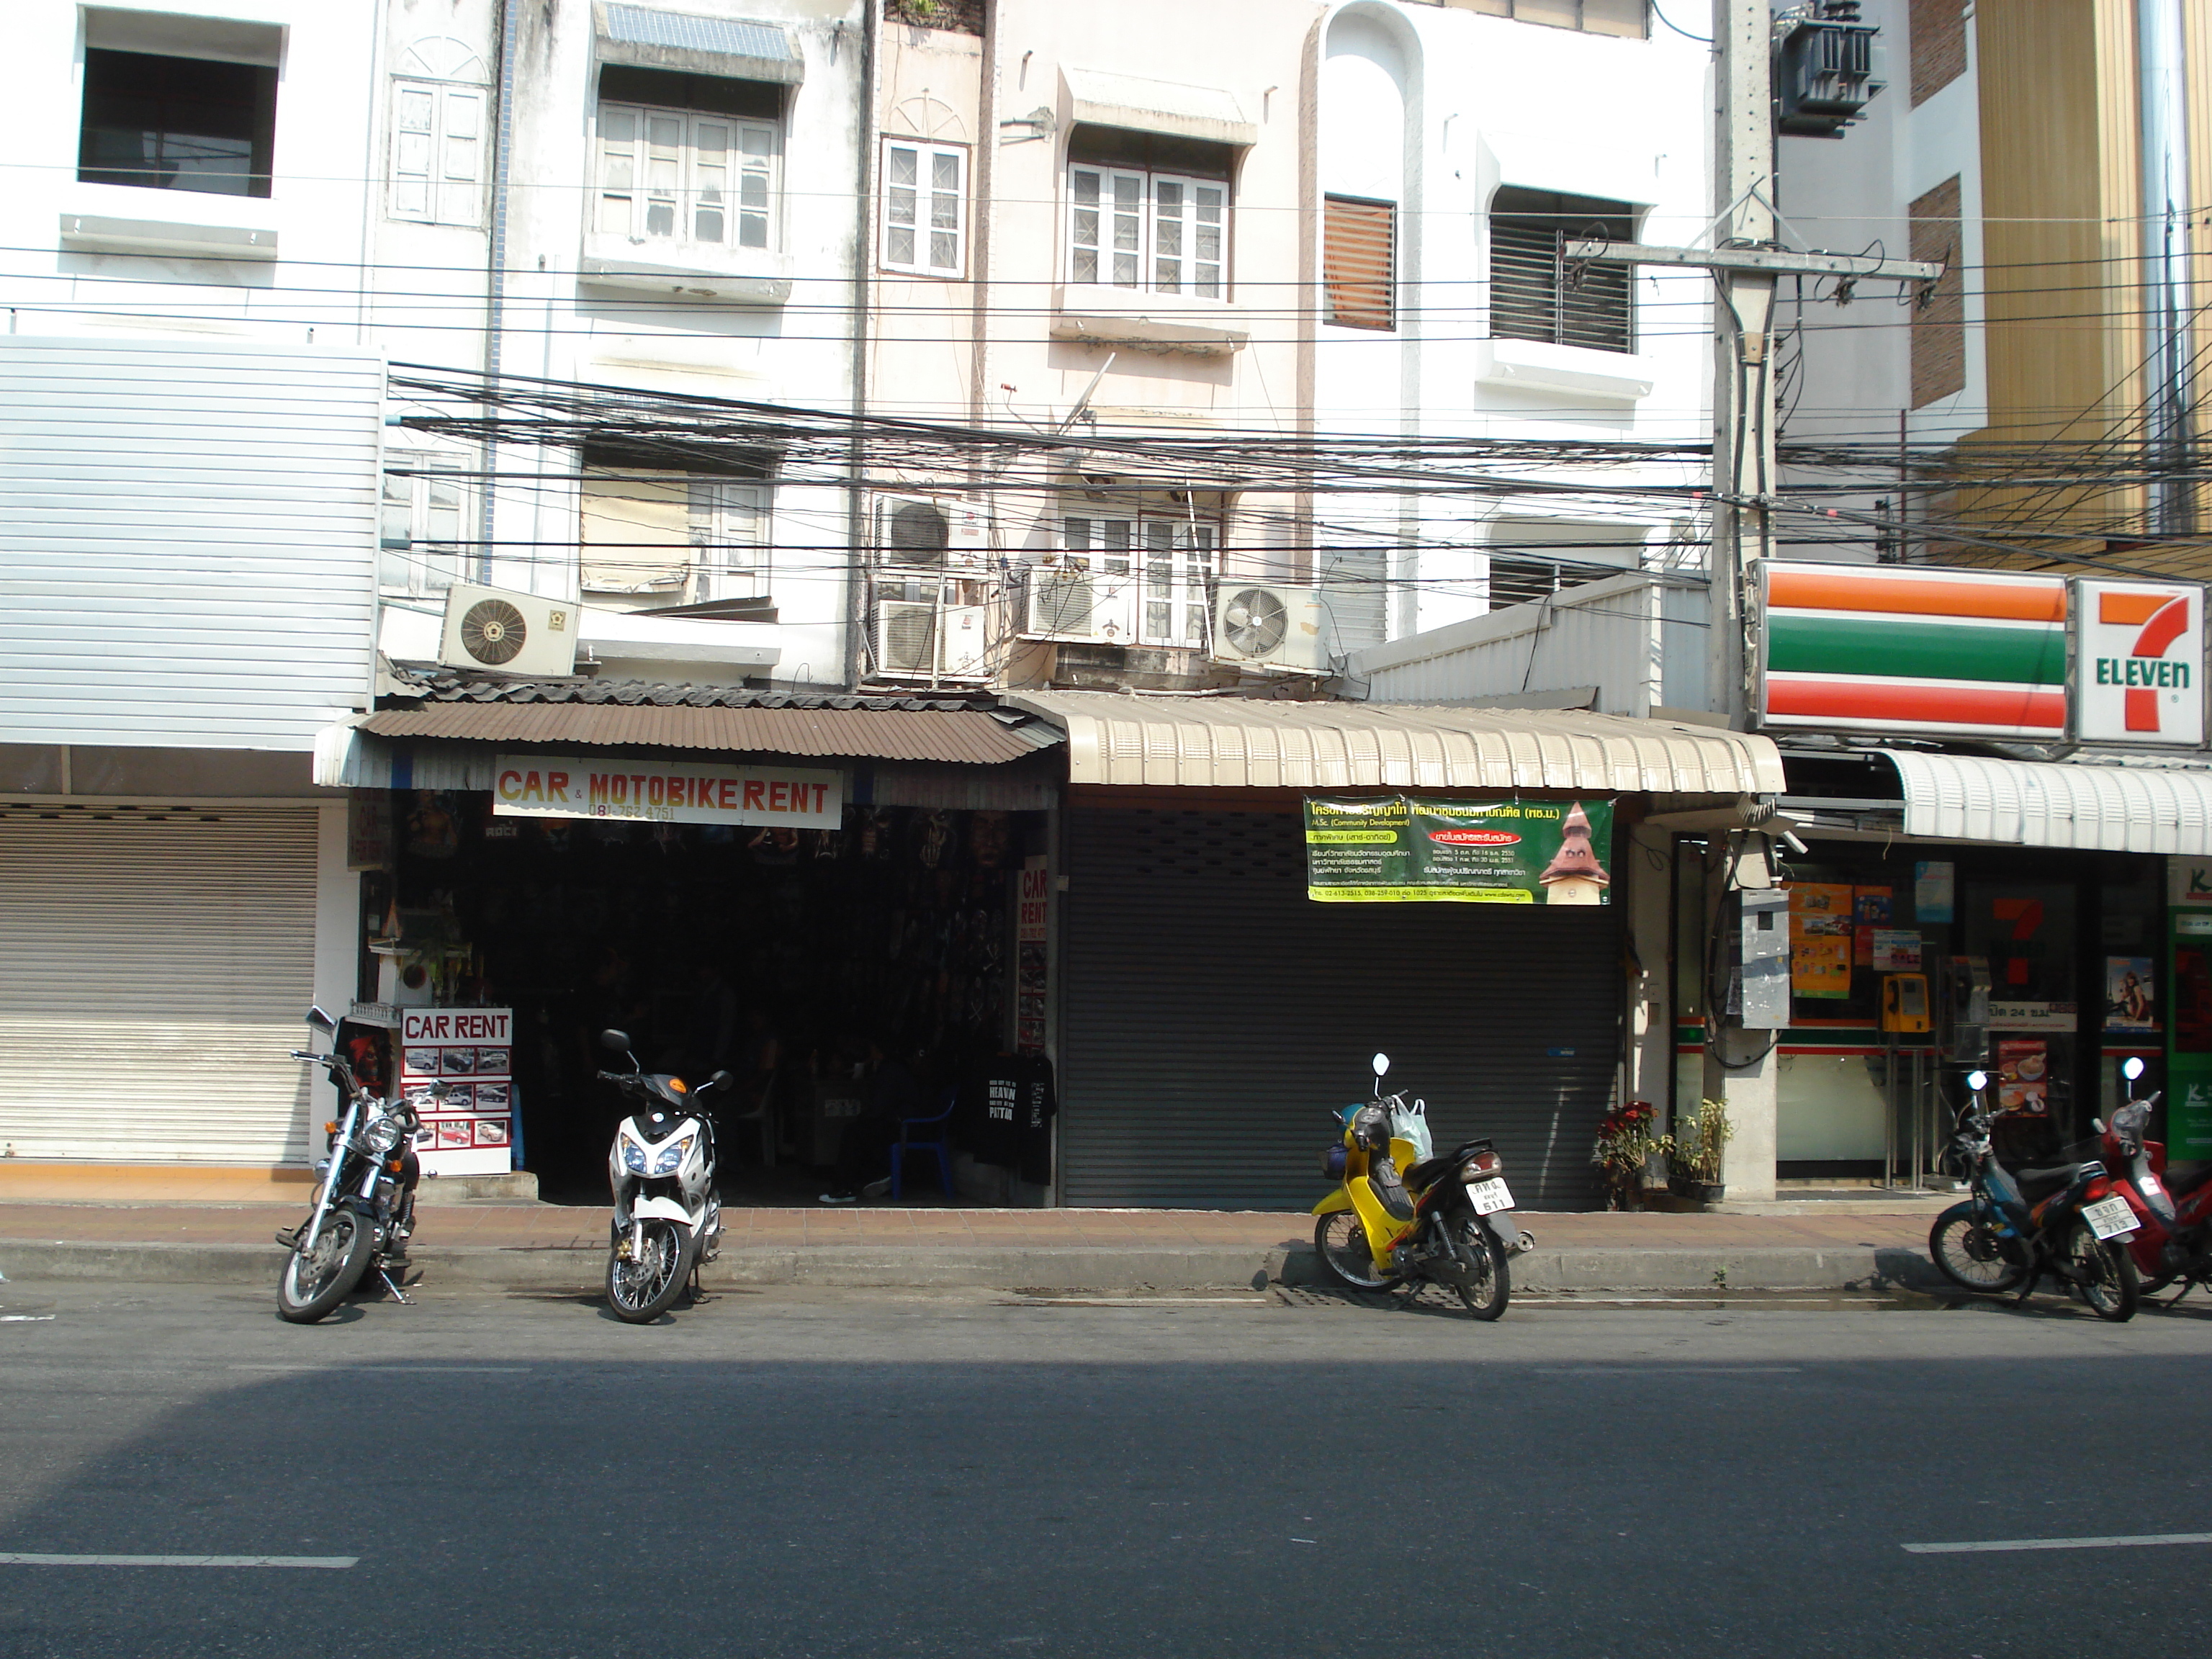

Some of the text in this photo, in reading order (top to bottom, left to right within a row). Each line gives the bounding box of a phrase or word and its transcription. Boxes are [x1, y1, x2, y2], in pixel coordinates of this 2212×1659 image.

[2098, 591, 2189, 732] 7
[498, 770, 569, 803] CAR
[575, 788, 583, 799] &
[743, 781, 829, 814] RENT
[1331, 819, 1367, 827] (Community
[1369, 819, 1410, 827] Development)
[1023, 869, 1047, 899] CAR
[1021, 902, 1047, 924] RENT
[2010, 1008, 2026, 1017] 24
[405, 1015, 509, 1039] CAR RENT
[1483, 1200, 1506, 1211] 511
[2104, 1220, 2128, 1233] 713
